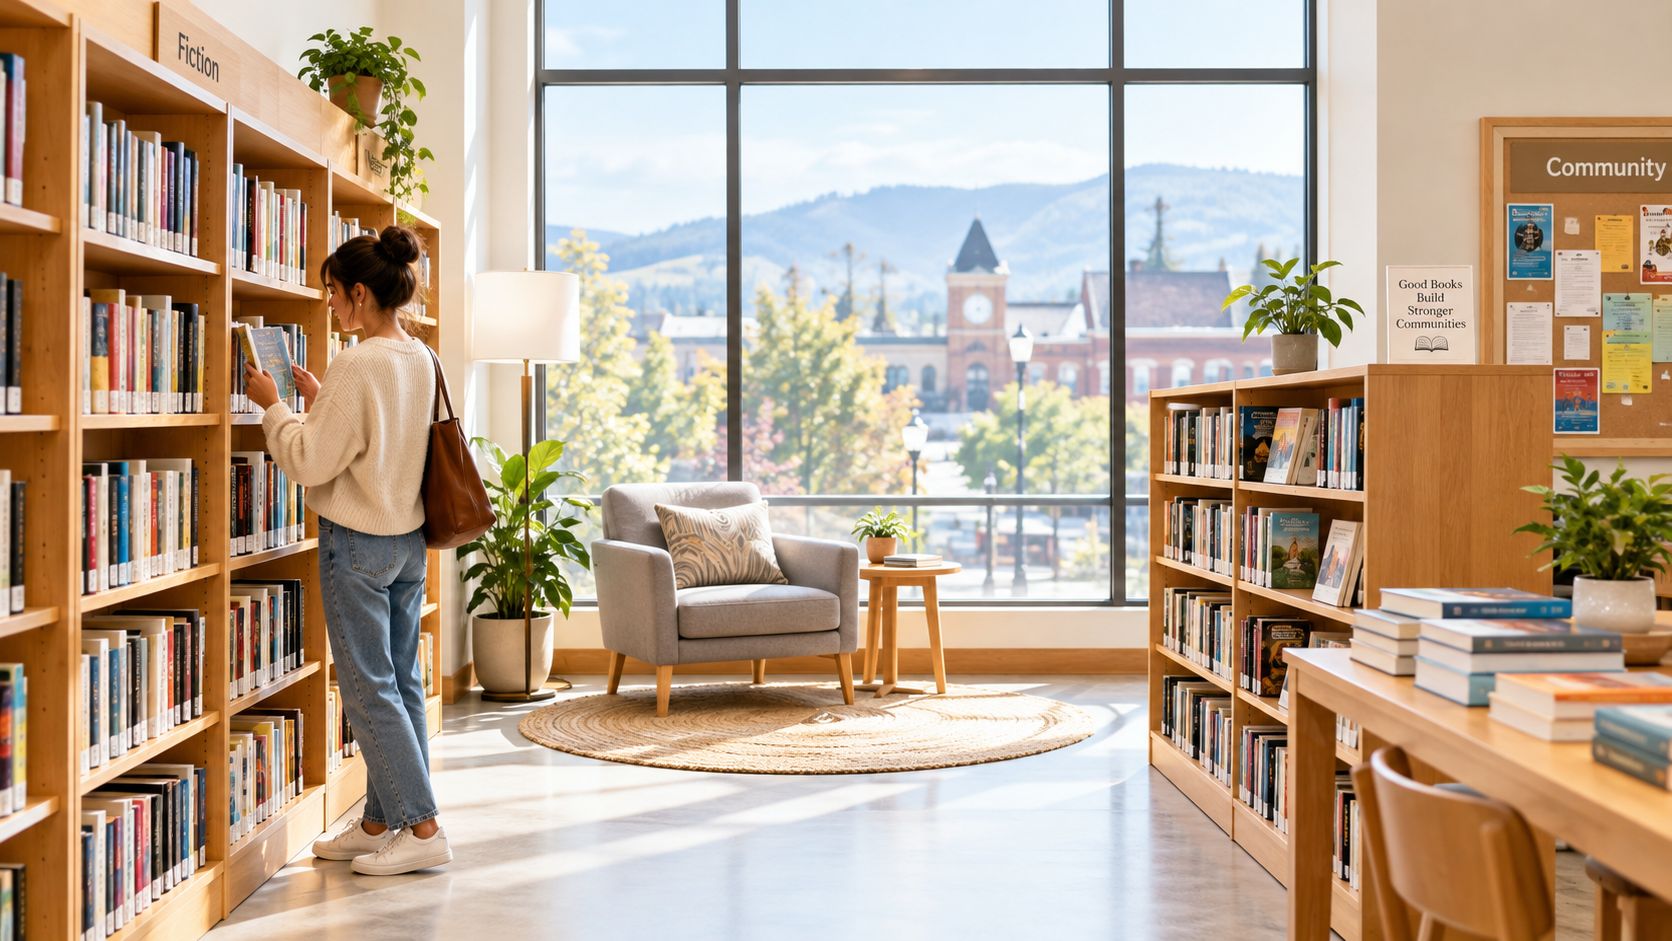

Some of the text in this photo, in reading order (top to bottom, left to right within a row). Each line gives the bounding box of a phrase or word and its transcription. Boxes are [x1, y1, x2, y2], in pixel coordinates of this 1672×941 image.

[178, 32, 219, 83] Fiction
[1546, 156, 1667, 182] Community
[1398, 279, 1463, 289] Good Books
[1417, 292, 1445, 303] Build
[1407, 305, 1454, 318] Stronger
[1395, 318, 1467, 329] Communities
